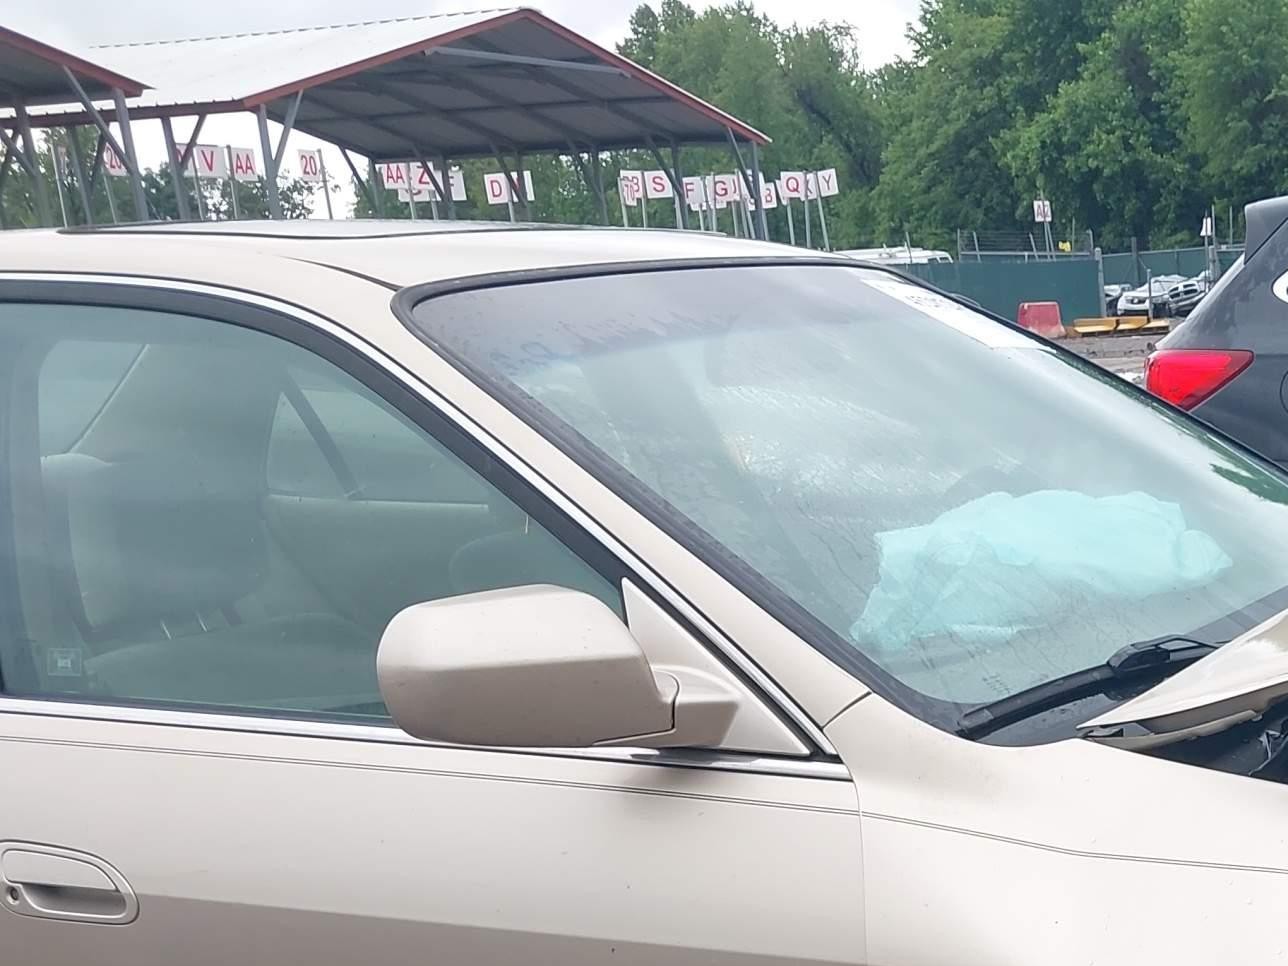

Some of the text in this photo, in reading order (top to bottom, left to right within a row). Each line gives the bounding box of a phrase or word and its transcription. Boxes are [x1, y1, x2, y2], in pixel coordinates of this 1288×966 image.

[201, 150, 214, 172] V
[235, 153, 256, 176] AA
[300, 154, 318, 176] 20
[386, 164, 405, 184] AA
[822, 173, 832, 191] Y
[490, 179, 503, 198] D
[652, 175, 666, 193] S
[684, 182, 695, 199] F
[714, 180, 728, 197] G
[786, 176, 800, 193] Q
